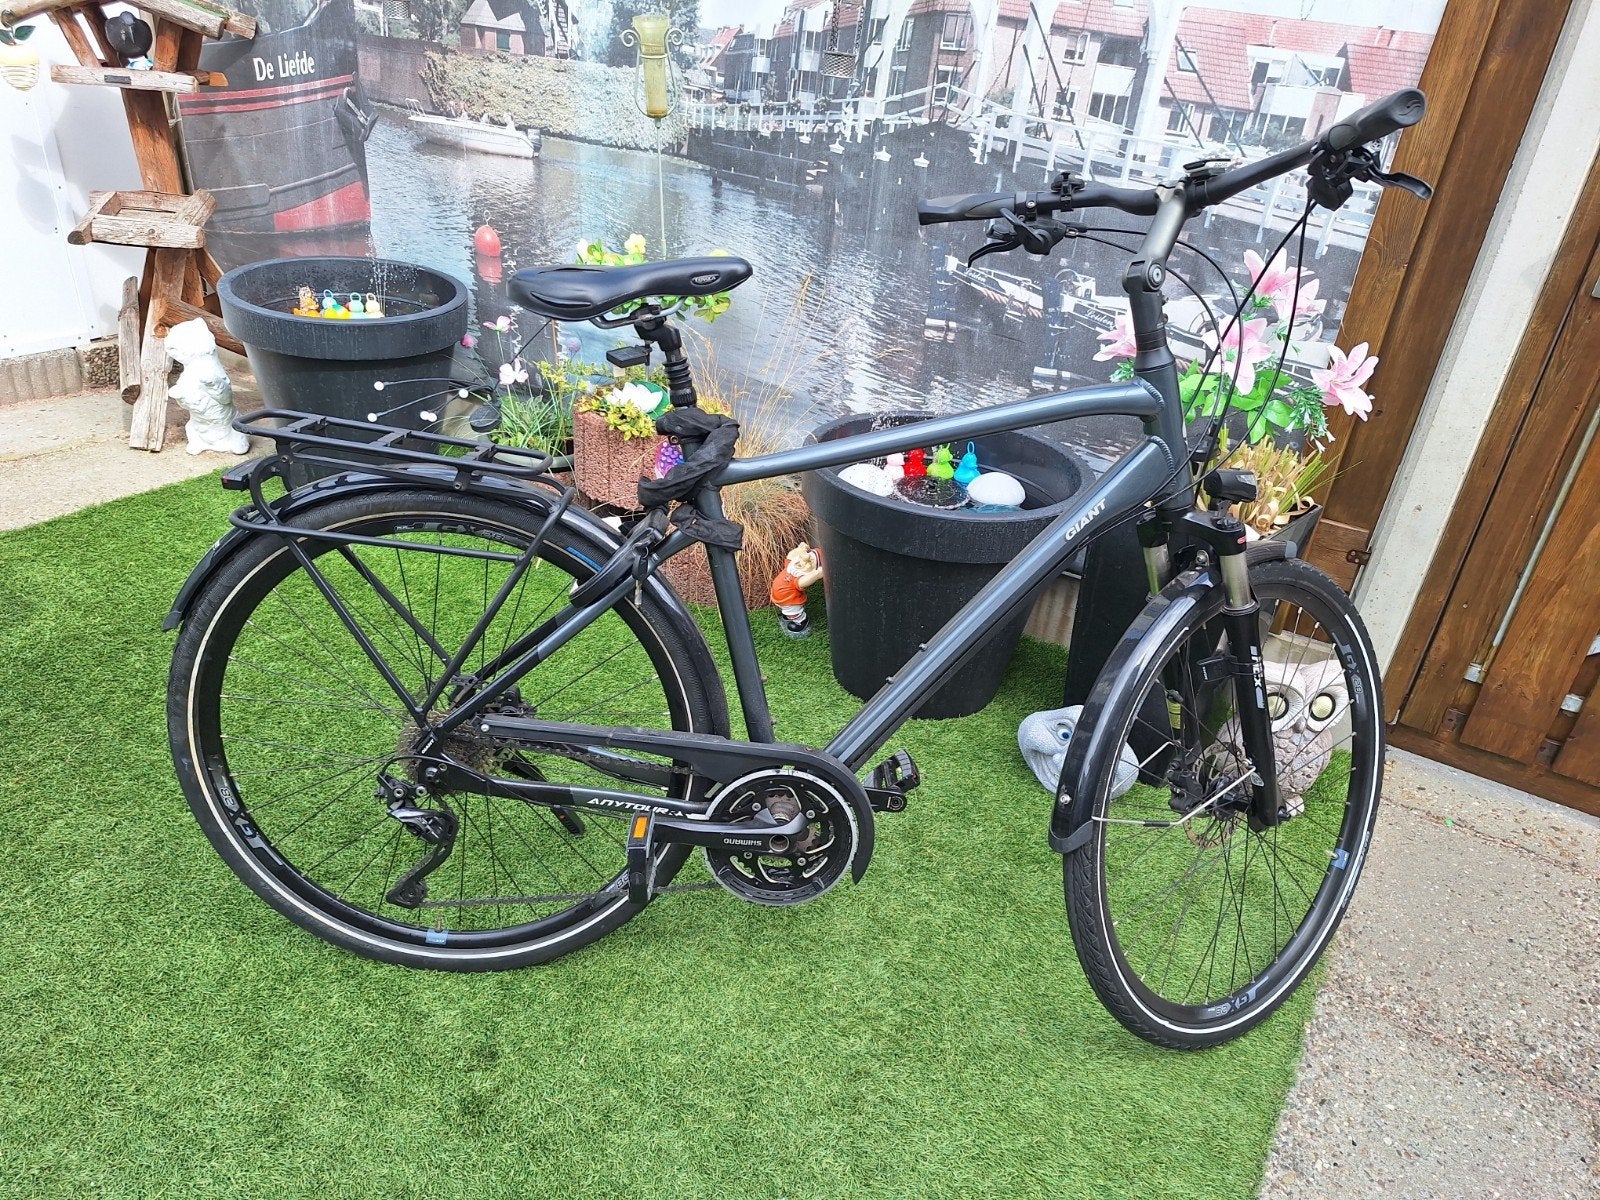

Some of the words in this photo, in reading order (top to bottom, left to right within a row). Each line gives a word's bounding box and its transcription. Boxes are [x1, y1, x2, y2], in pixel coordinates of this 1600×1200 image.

[253, 57, 275, 81] De
[277, 50, 316, 78] Liefde
[1065, 498, 1106, 541] GIANT
[723, 838, 762, 846] SHIMANO
